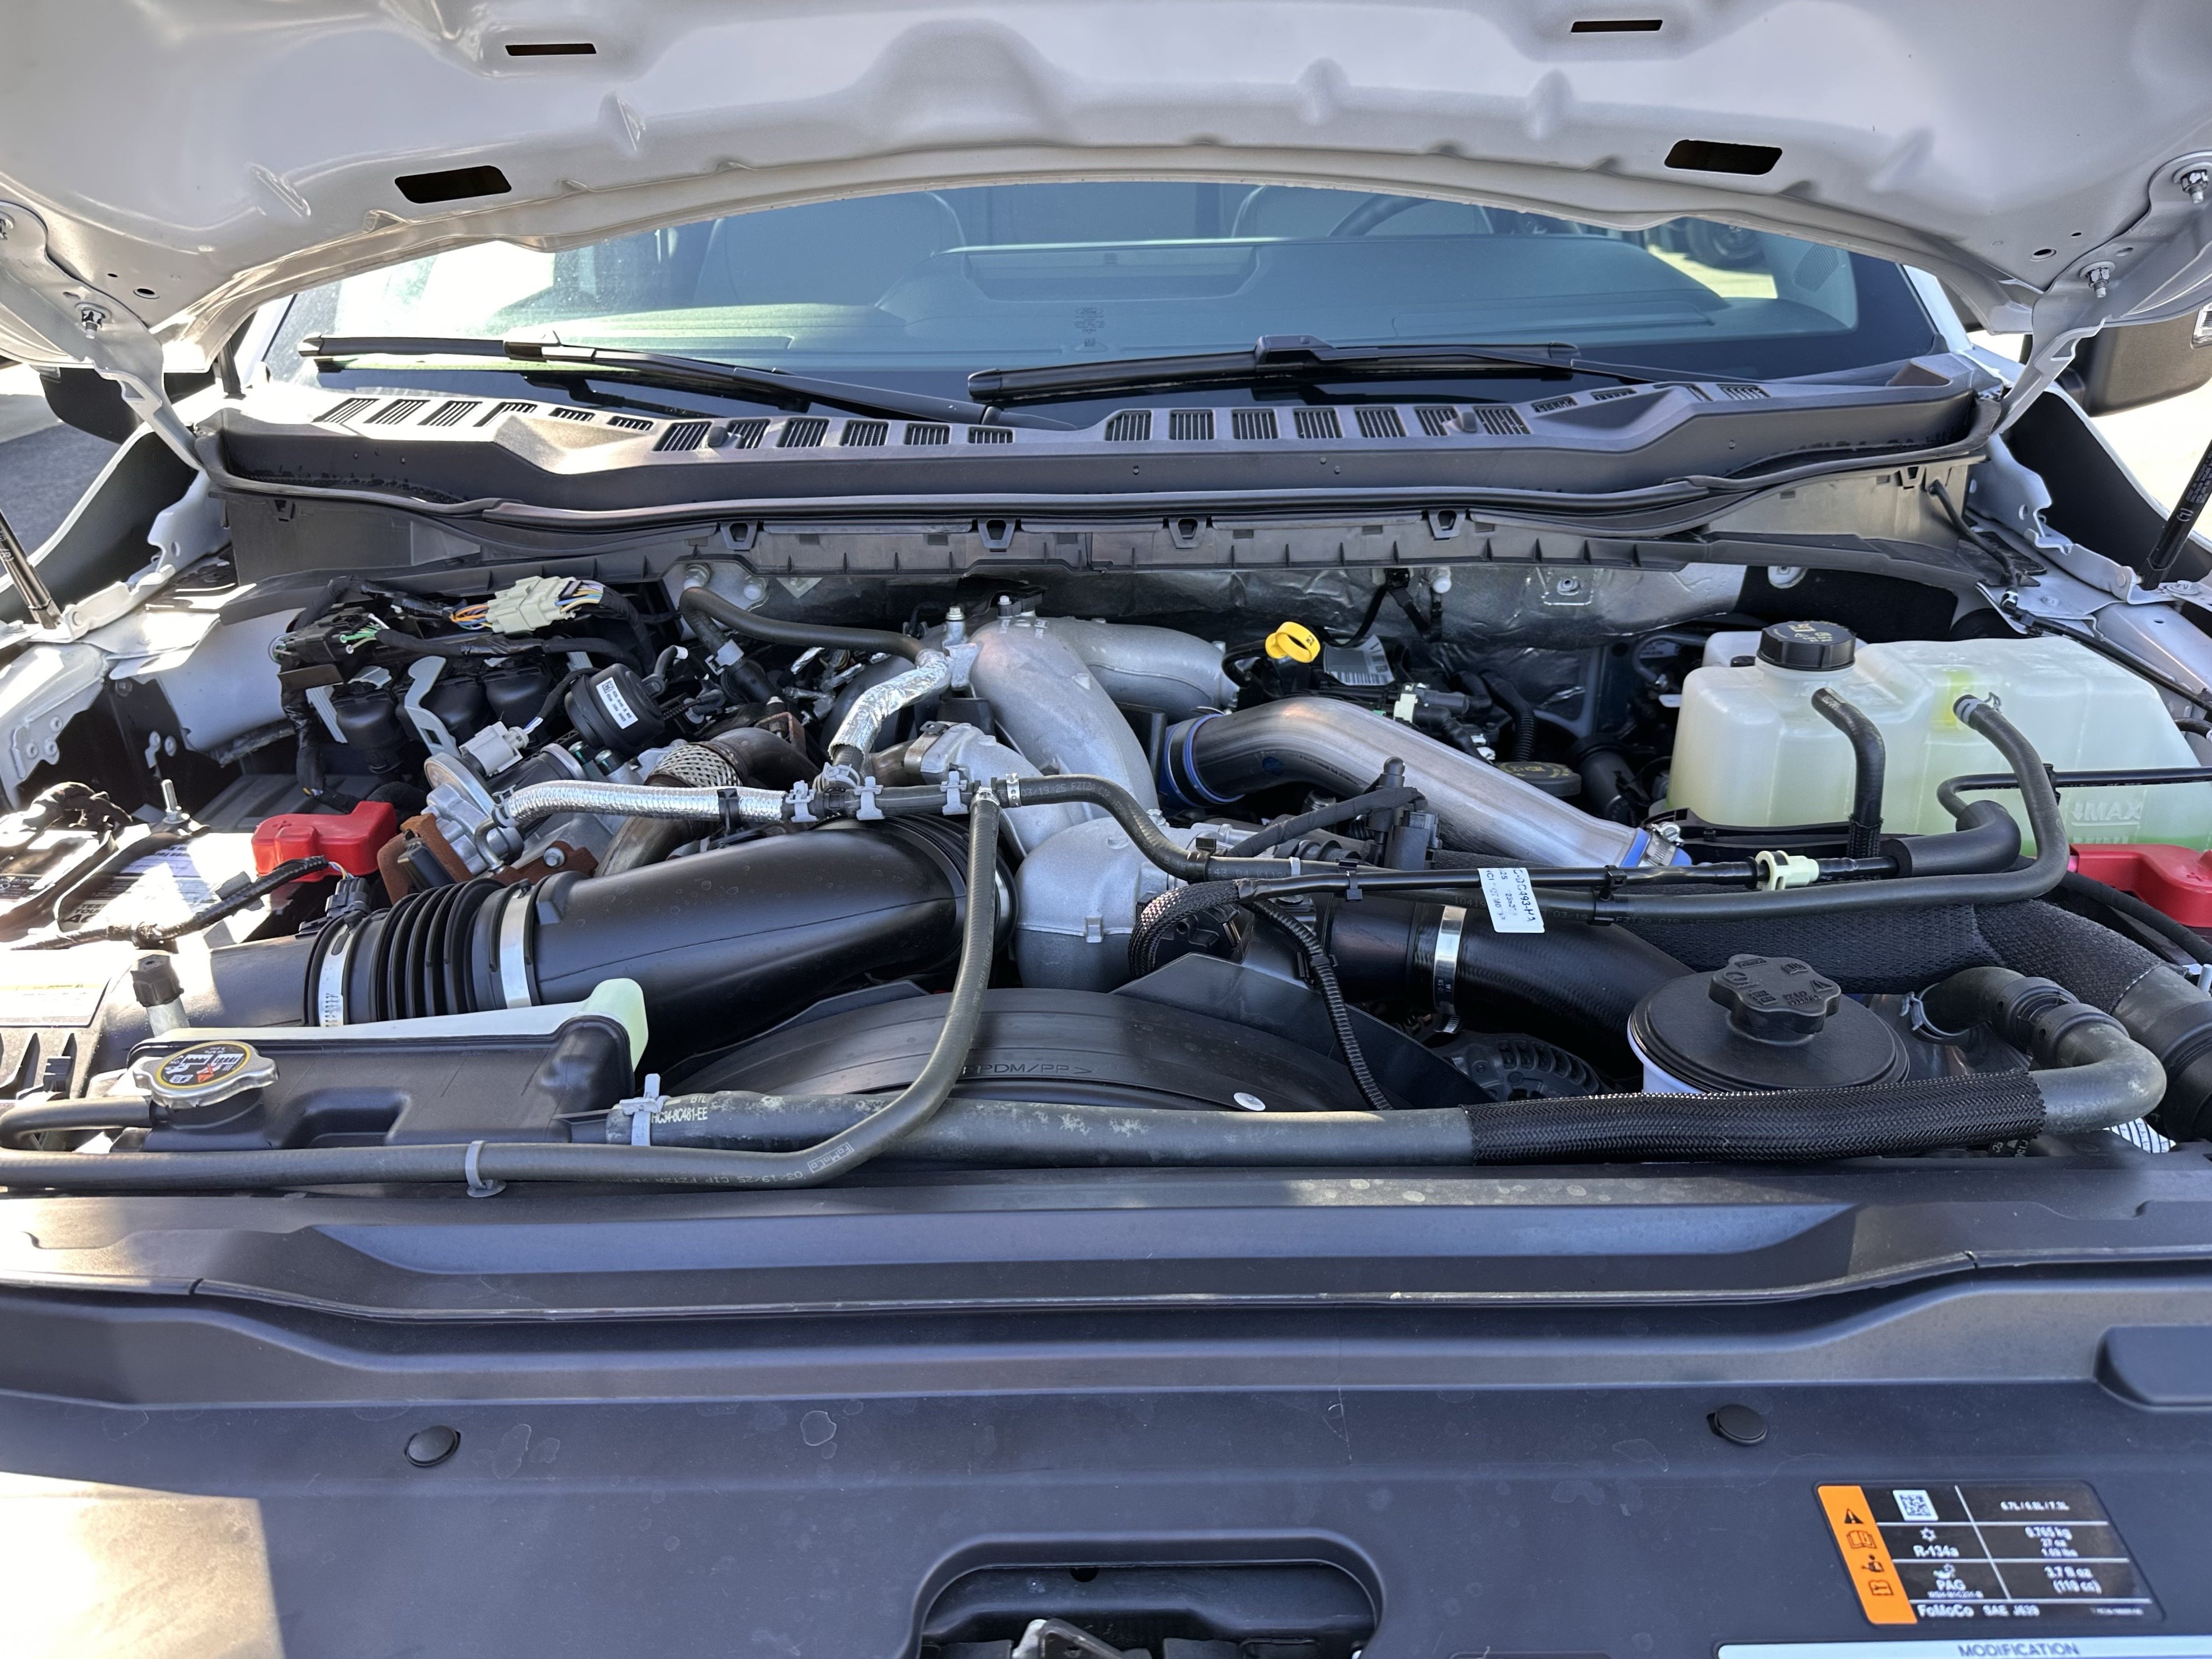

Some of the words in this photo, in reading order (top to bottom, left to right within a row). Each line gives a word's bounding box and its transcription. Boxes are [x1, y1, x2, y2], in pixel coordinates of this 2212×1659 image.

[2084, 800, 2142, 821] MAX
[809, 1143, 852, 1171] FoMoCo
[2055, 1526, 2073, 1540] kg
[1913, 1544, 1960, 1557] R-134a
[2044, 1566, 2063, 1578] 3.7
[2076, 1568, 2093, 1578] oz
[1936, 1579, 1966, 1591] PAG
[2079, 1580, 2102, 1594] cc)
[1917, 1604, 1974, 1618] FoMoCo
[1982, 1605, 2010, 1616] SAE
[2012, 1605, 2040, 1617] J639
[1958, 1642, 2080, 1658] MODIFICATION
